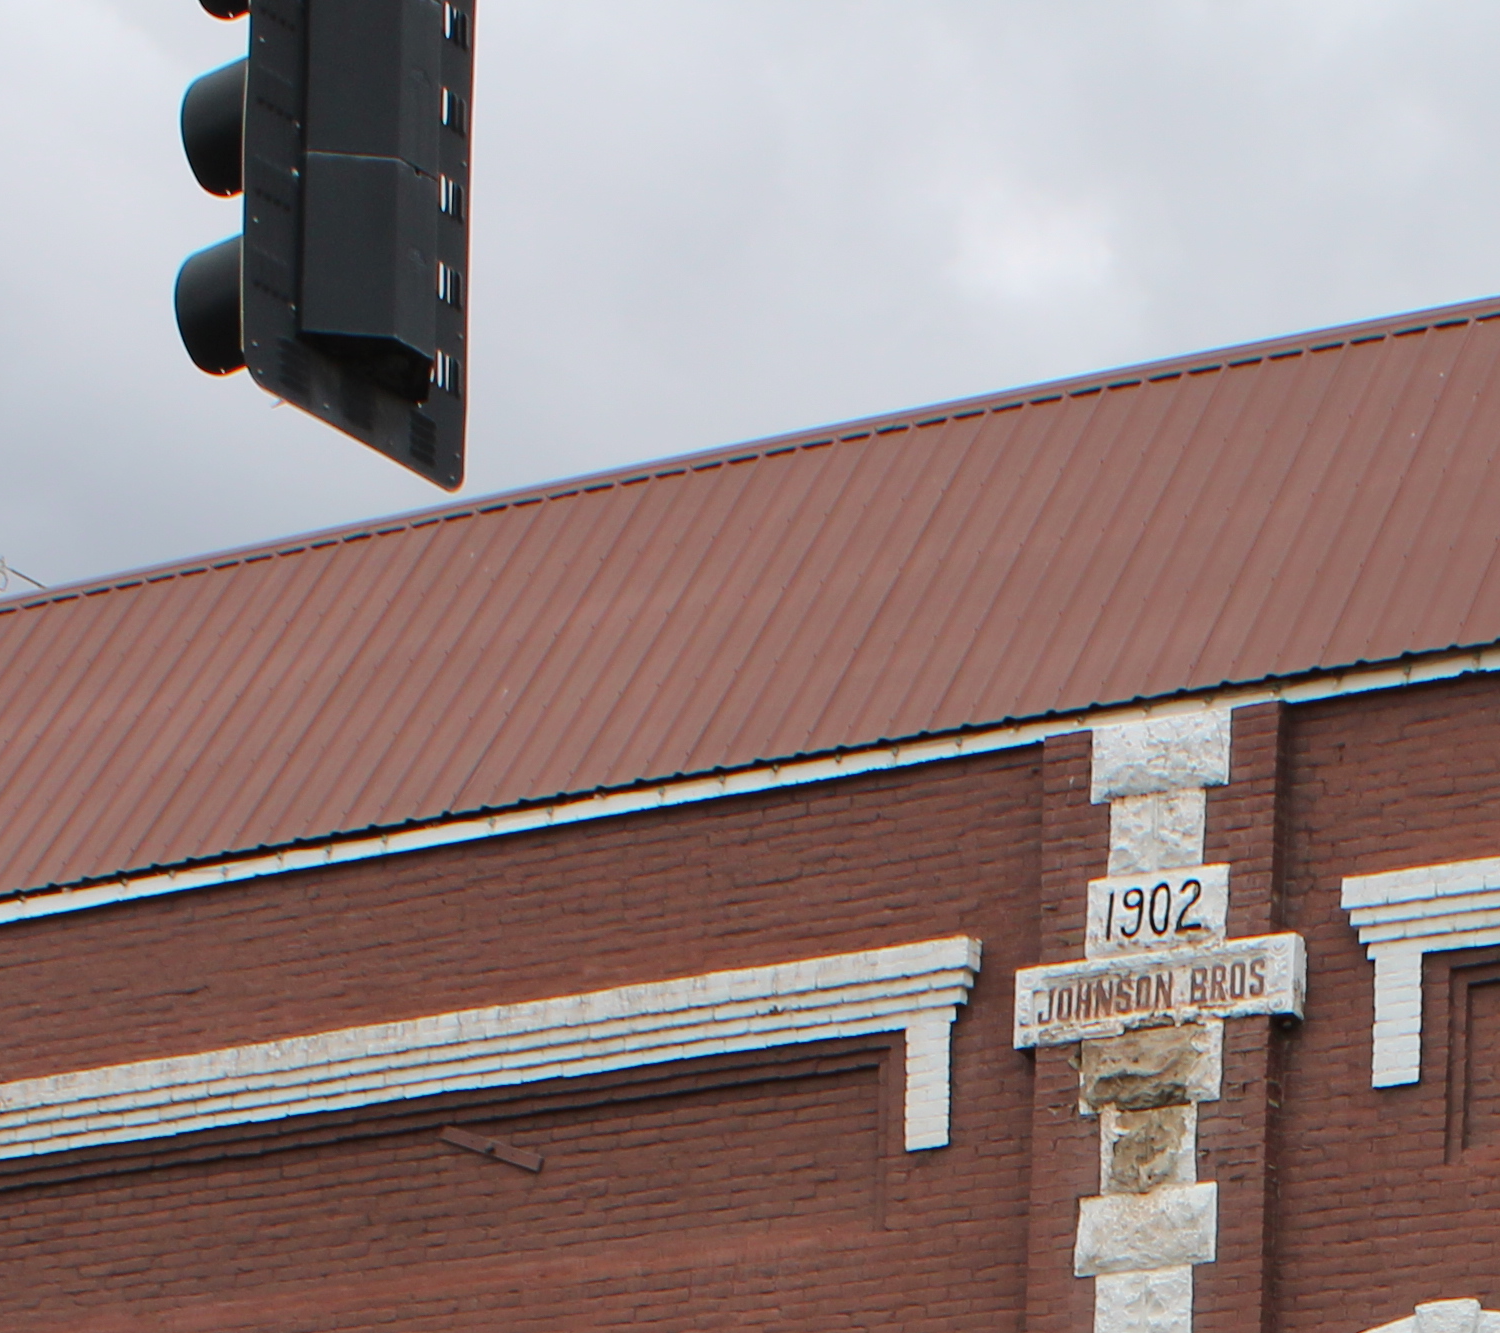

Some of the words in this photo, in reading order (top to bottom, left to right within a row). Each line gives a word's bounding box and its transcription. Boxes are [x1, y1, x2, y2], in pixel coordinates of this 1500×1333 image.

[1105, 879, 1202, 941] 1902
[1036, 969, 1174, 1025] JOHNSON
[1190, 957, 1267, 1006] BROS
